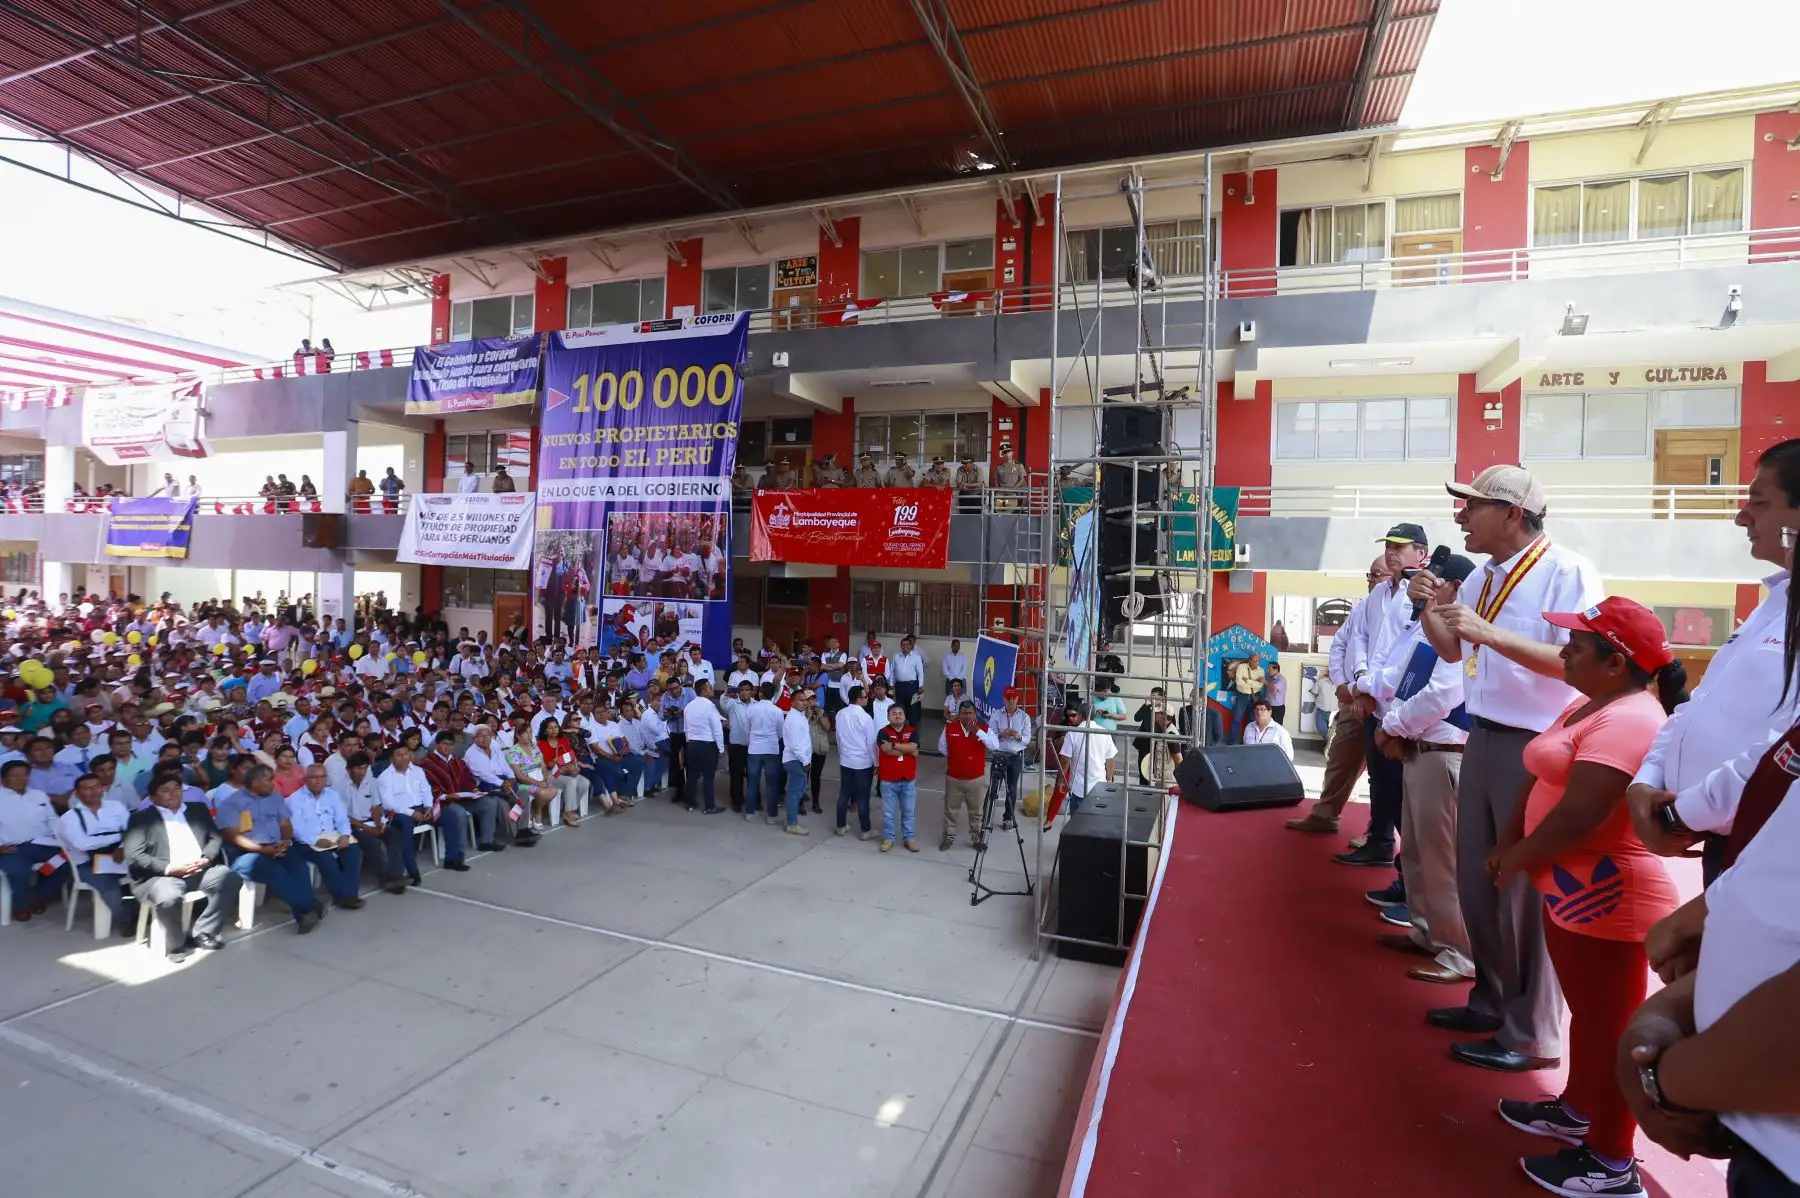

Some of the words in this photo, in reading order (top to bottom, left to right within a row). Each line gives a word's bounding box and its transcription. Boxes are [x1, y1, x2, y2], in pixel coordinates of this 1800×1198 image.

[693, 313, 735, 325] COFOPRI
[1539, 372, 1585, 387] ARTE
[1644, 366, 1728, 383] CULTURA
[572, 370, 643, 413] 100
[653, 363, 734, 409] 000
[542, 432, 591, 448] NUEVOS
[594, 421, 738, 445] PROPIETARIOS
[559, 457, 577, 469] EN
[579, 455, 620, 468] TODO
[624, 447, 650, 467] EL
[656, 440, 714, 466] PERÚ
[541, 486, 554, 498] EN
[556, 486, 570, 497] LO
[573, 486, 595, 497] QUE
[599, 484, 615, 496] VA
[618, 484, 639, 496] DEL
[645, 482, 722, 496] GOBIERNO
[436, 512, 449, 520] DE
[466, 512, 505, 522] MILLONES
[507, 513, 520, 522] DE
[792, 516, 857, 529] Lambayeque
[450, 523, 462, 532] DE
[463, 523, 518, 534] PROPIEDAD
[459, 534, 512, 545] PERUANOS
